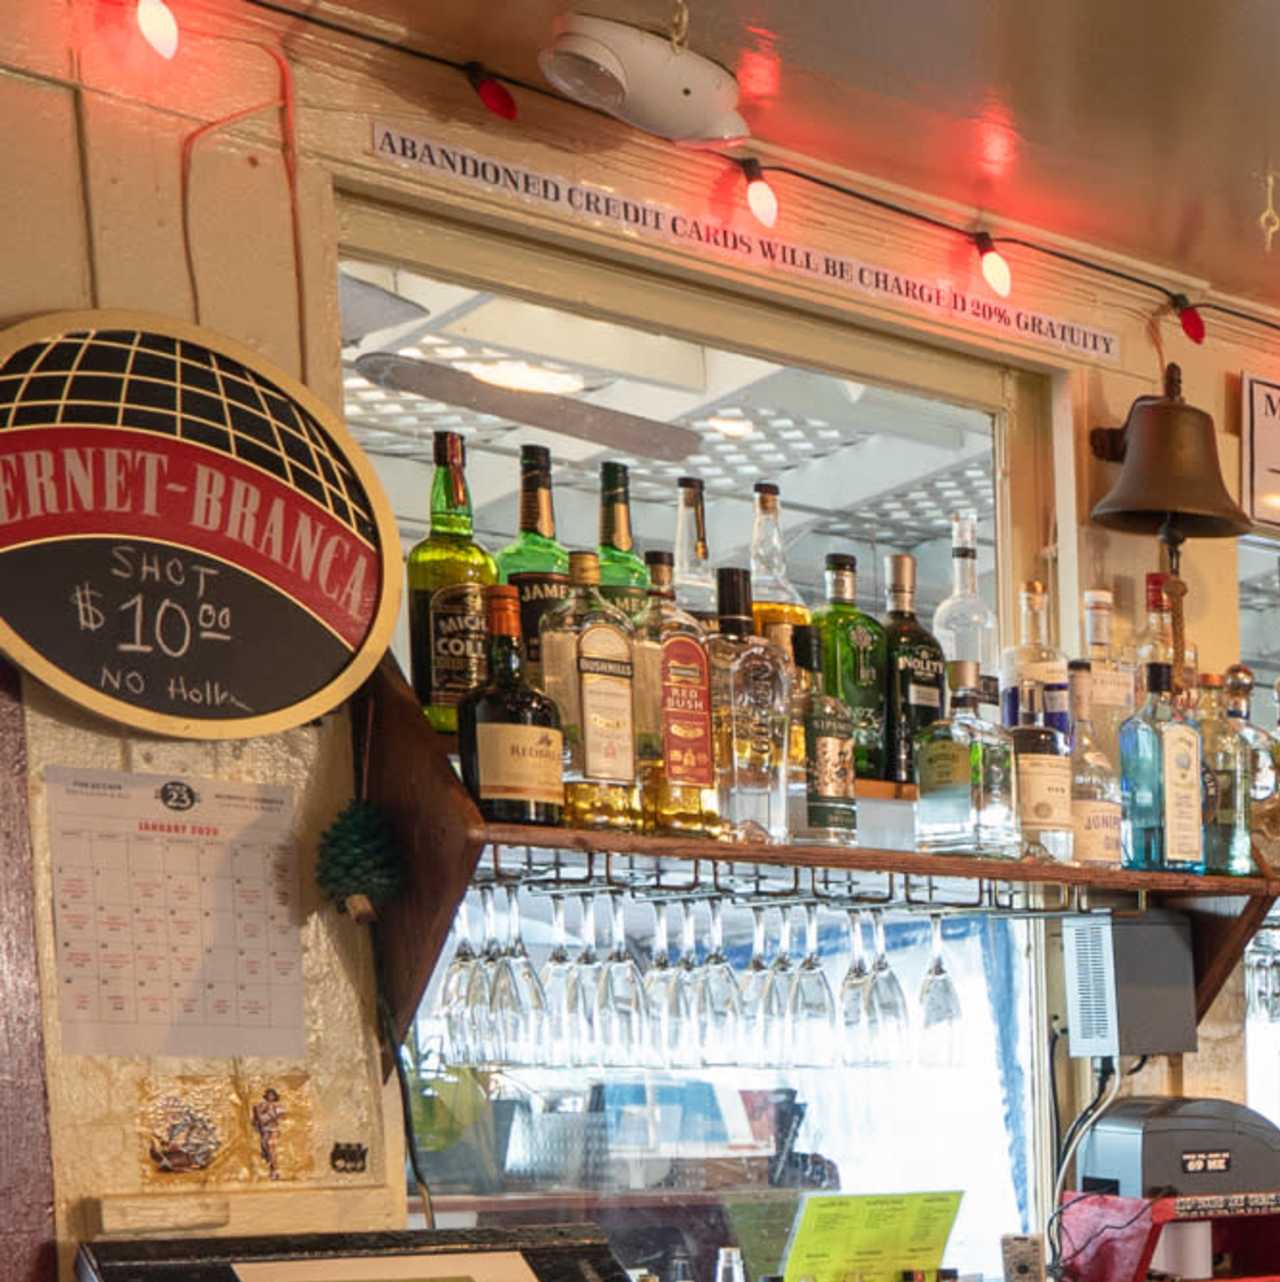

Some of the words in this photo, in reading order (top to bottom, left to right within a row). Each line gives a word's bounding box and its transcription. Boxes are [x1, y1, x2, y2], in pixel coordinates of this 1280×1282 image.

[378, 131, 560, 203] ABANDONED
[567, 186, 666, 231] CREDIT
[671, 217, 752, 255] CARDS
[760, 240, 819, 272] WILL
[825, 257, 853, 282] BE
[971, 299, 1011, 328] 20%
[1016, 311, 1114, 356] GRATUITY
[0, 445, 372, 624] ERNET-BRANCA
[111, 545, 219, 599] SHOT
[523, 584, 568, 601] JAME
[439, 616, 488, 634] MICH
[436, 639, 486, 658] COLL
[101, 663, 145, 694] NO
[138, 821, 187, 835] JANUARY
